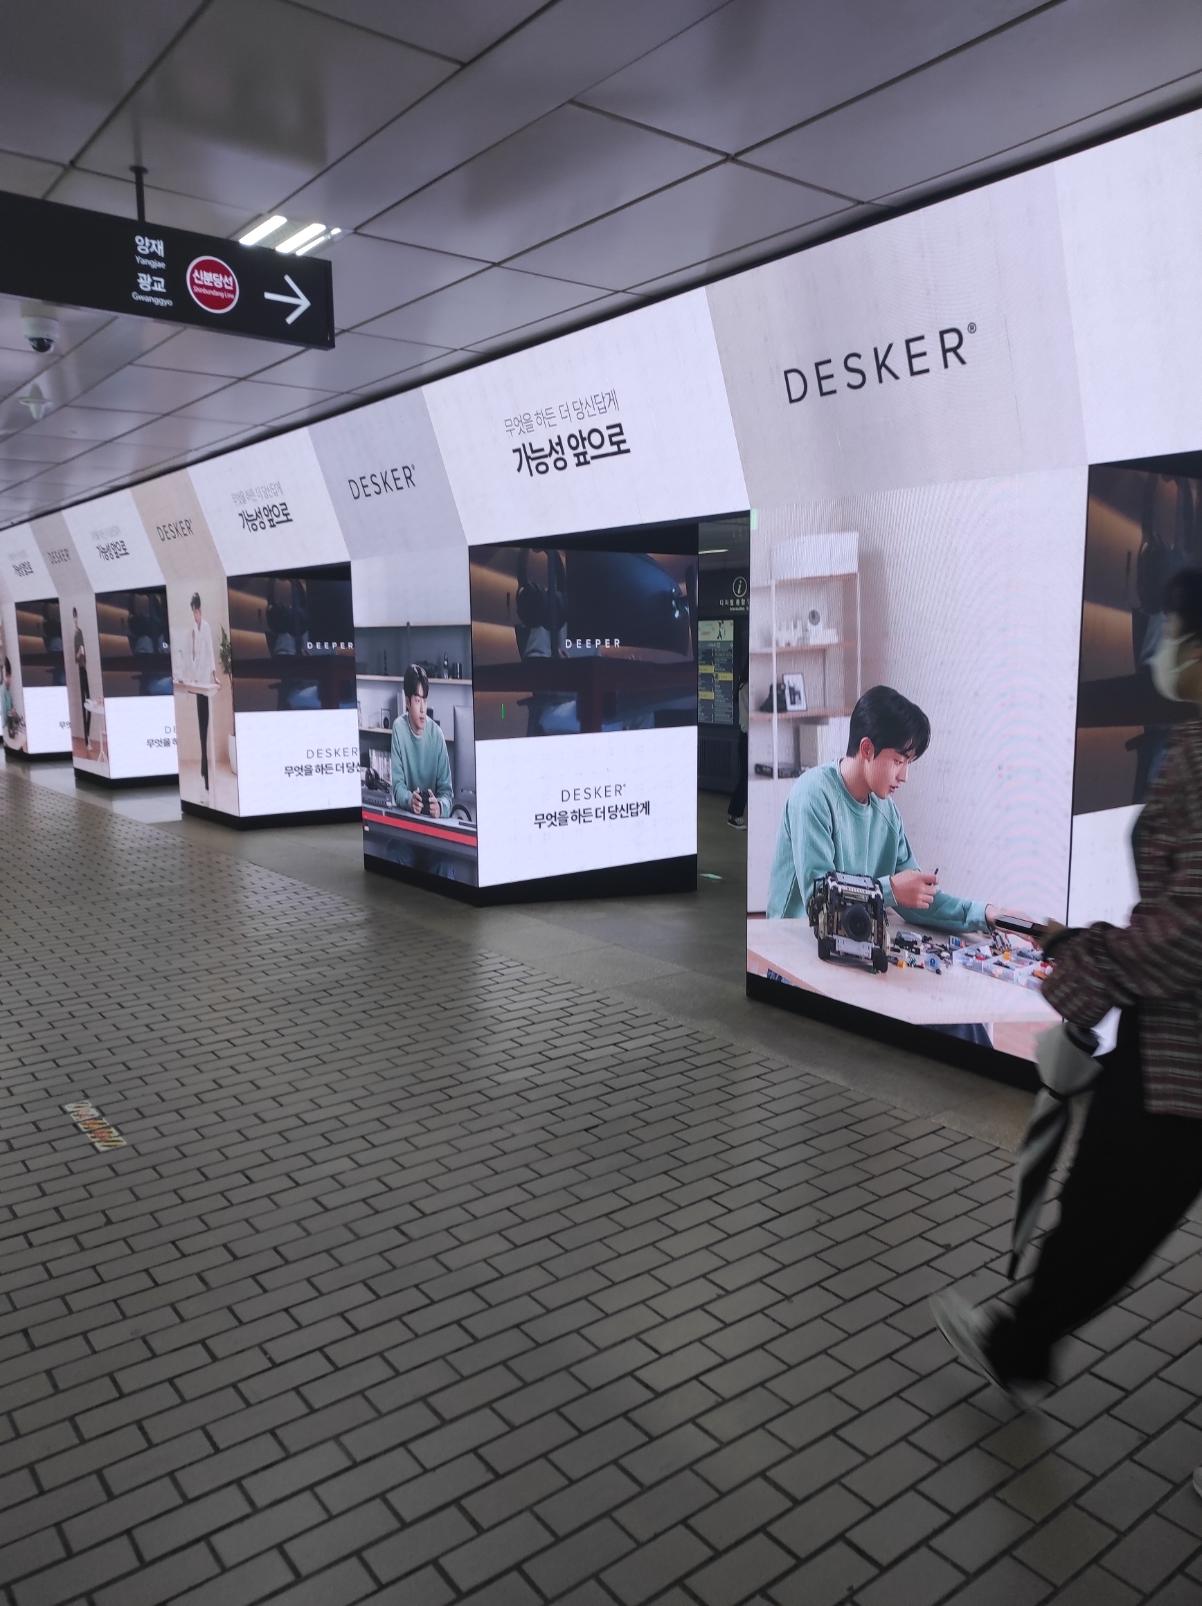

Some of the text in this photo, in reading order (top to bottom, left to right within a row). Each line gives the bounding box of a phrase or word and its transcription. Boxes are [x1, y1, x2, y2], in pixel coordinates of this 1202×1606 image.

[134, 235, 165, 258] 양재
[134, 255, 166, 269] Yangjae
[136, 272, 167, 292] 광교
[191, 269, 235, 291] 신분당선
[131, 291, 173, 307] Gwanggyo
[503, 388, 620, 438] 무엇을 하든 더 당신답게
[512, 422, 631, 477] 가능성 앞으로
[238, 502, 293, 533] 가능성 앞으로
[306, 641, 354, 650] DEEPER
[565, 638, 621, 649] DEEPER
[284, 763, 313, 778] 무엇을
[314, 762, 334, 775] 하든
[335, 762, 345, 774] 더
[533, 800, 651, 829] 무엇을 하든 더 당신답게
